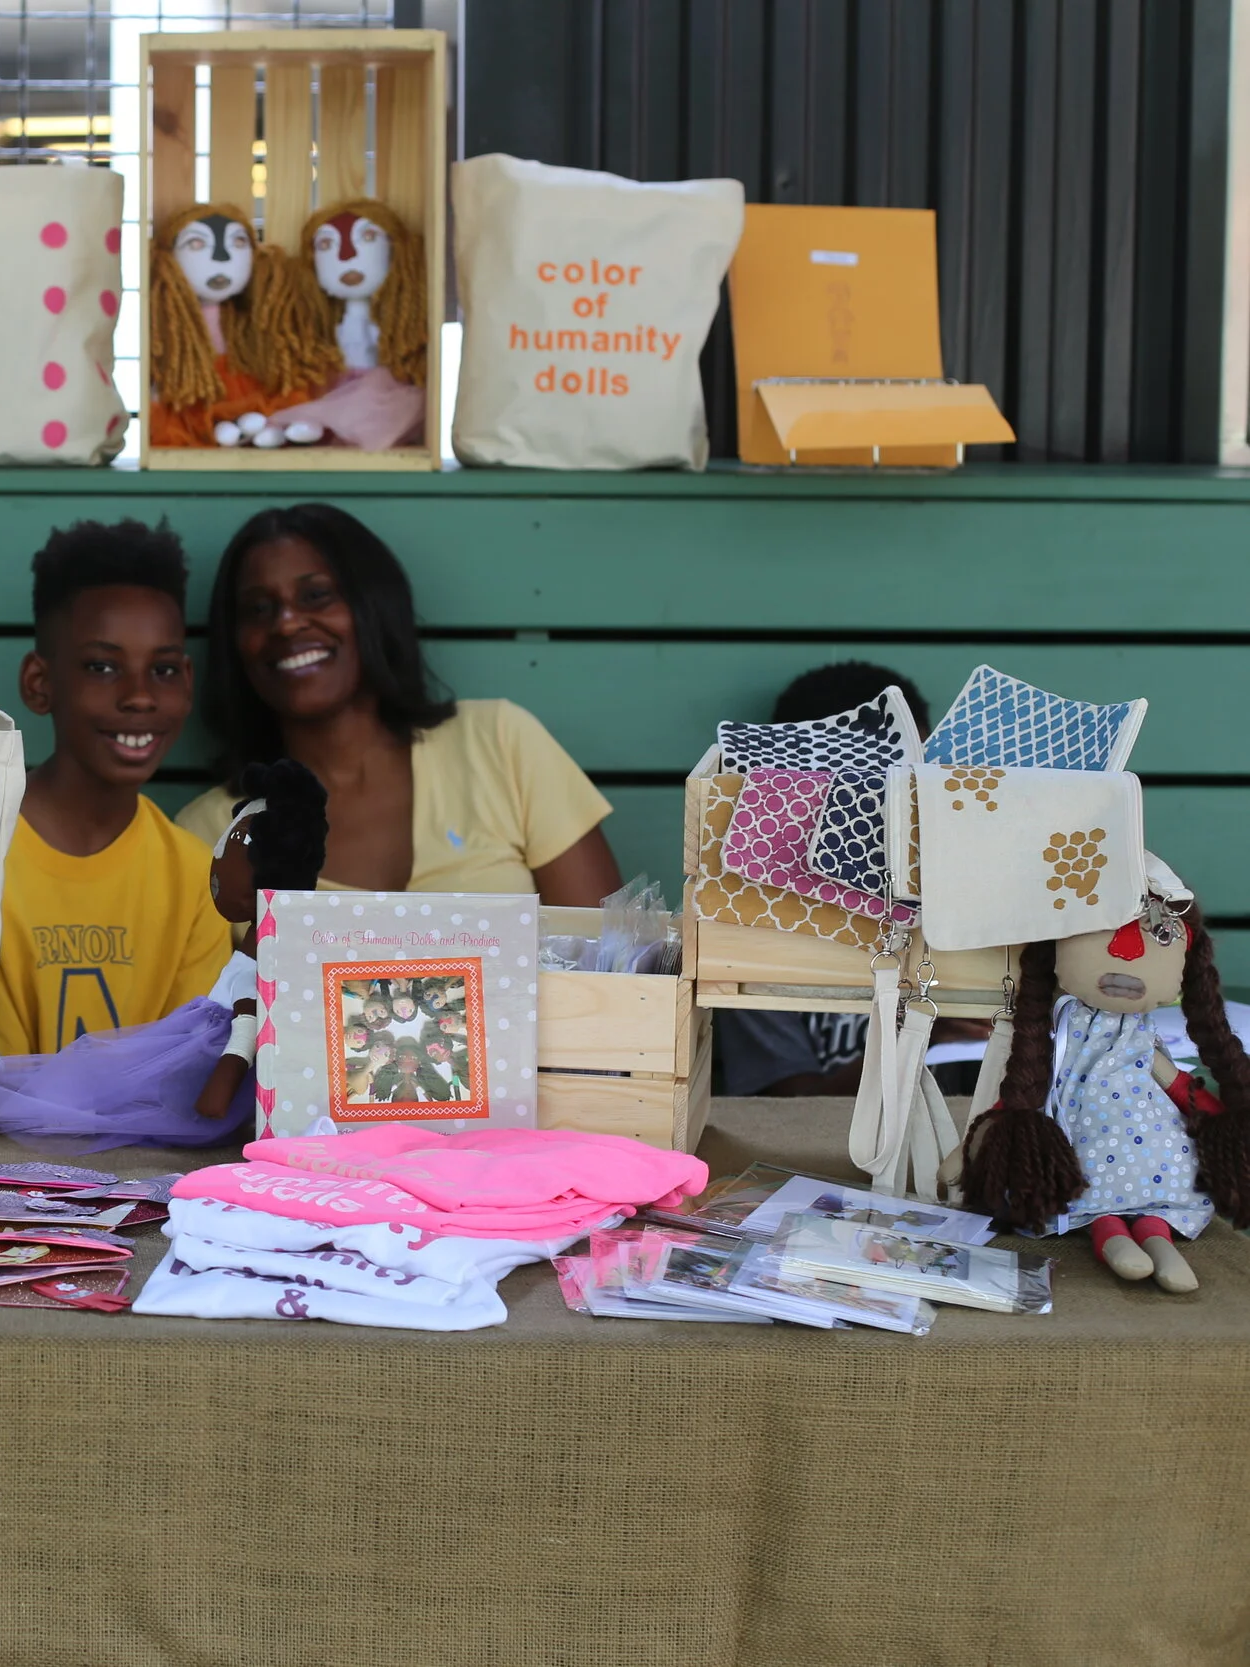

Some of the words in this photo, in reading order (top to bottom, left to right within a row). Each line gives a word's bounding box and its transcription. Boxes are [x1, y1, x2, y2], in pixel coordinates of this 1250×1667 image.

[537, 259, 642, 285] color
[572, 292, 609, 318] of
[509, 324, 681, 361] humanity
[534, 365, 630, 396] dolls
[312, 930, 338, 945] Color
[341, 931, 351, 947] of
[353, 930, 403, 949] Humanity
[440, 933, 456, 946] and
[459, 933, 500, 947] Products
